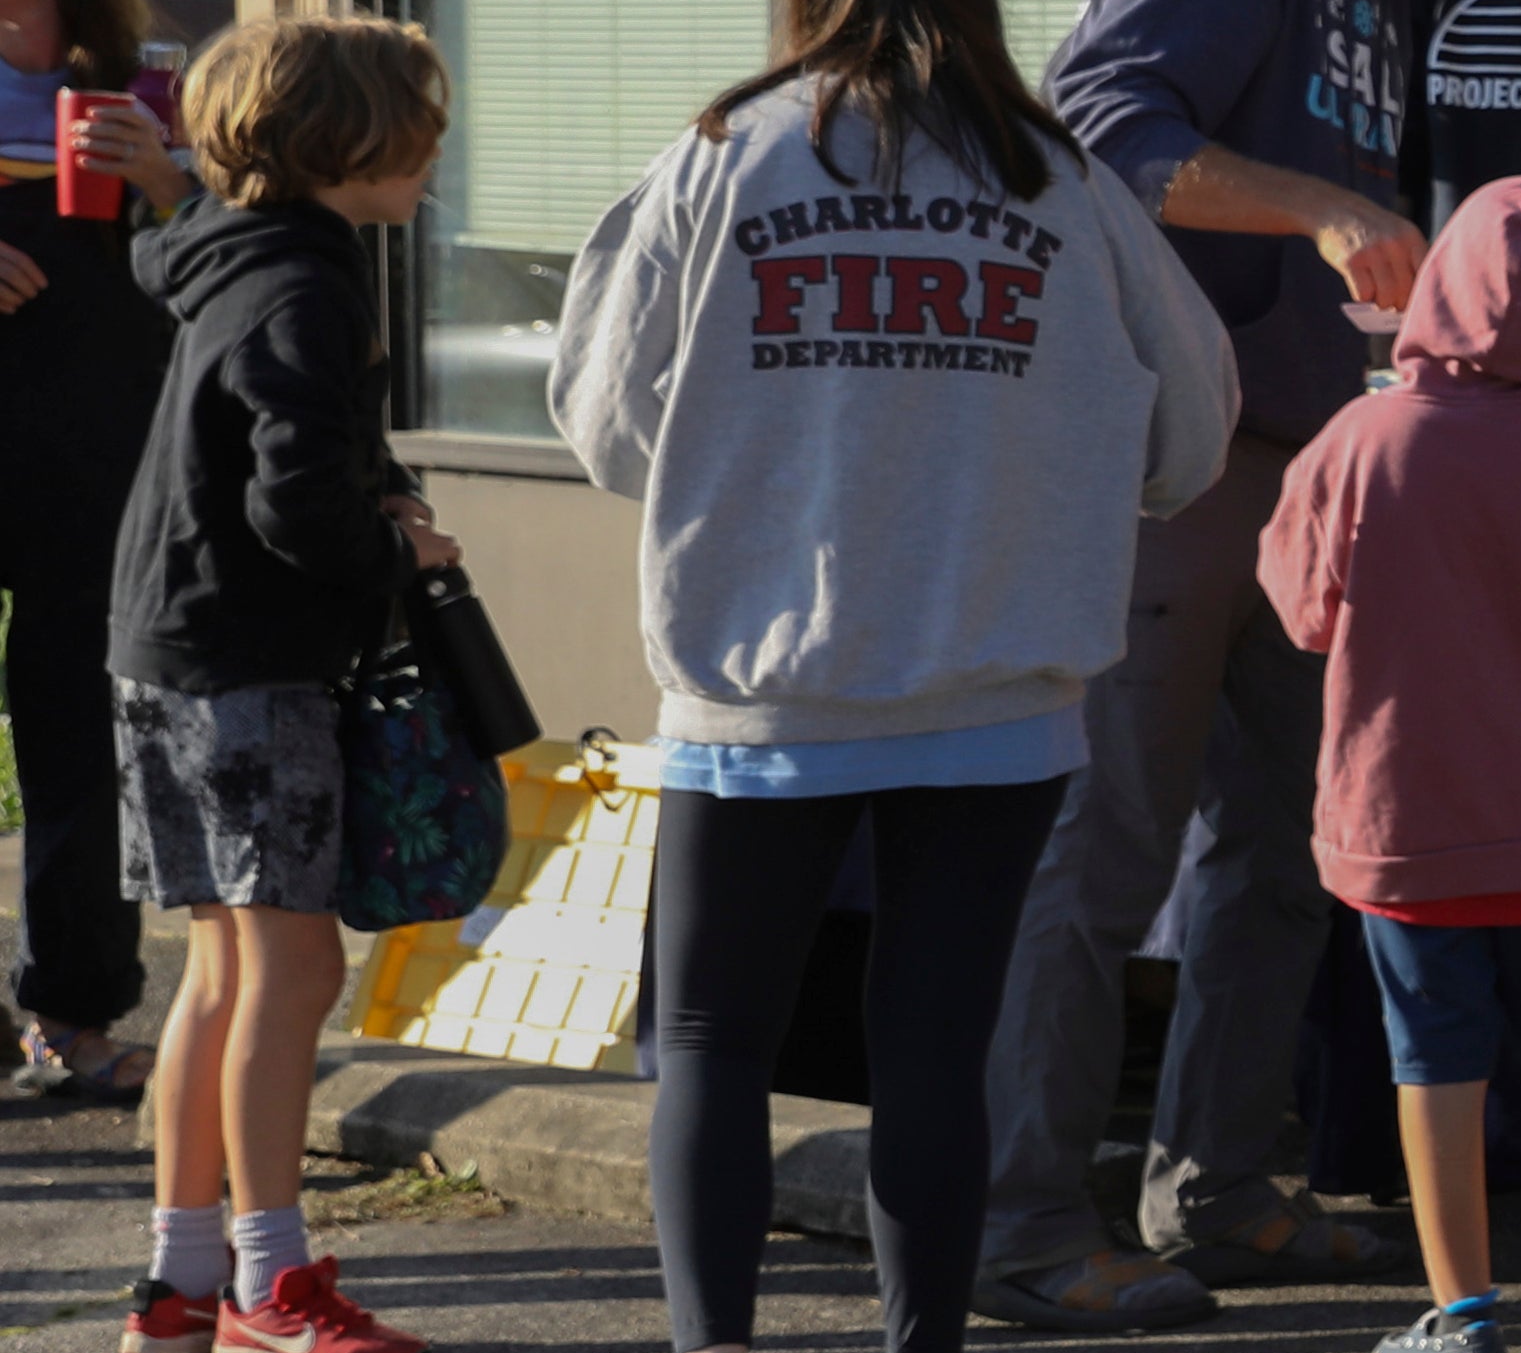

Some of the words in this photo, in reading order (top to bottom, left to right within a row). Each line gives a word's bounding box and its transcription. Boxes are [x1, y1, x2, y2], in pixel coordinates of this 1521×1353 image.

[735, 195, 1063, 270] CHARLOTTE
[751, 254, 1044, 346] FIRE
[752, 340, 1032, 378] DEPARTMENT
